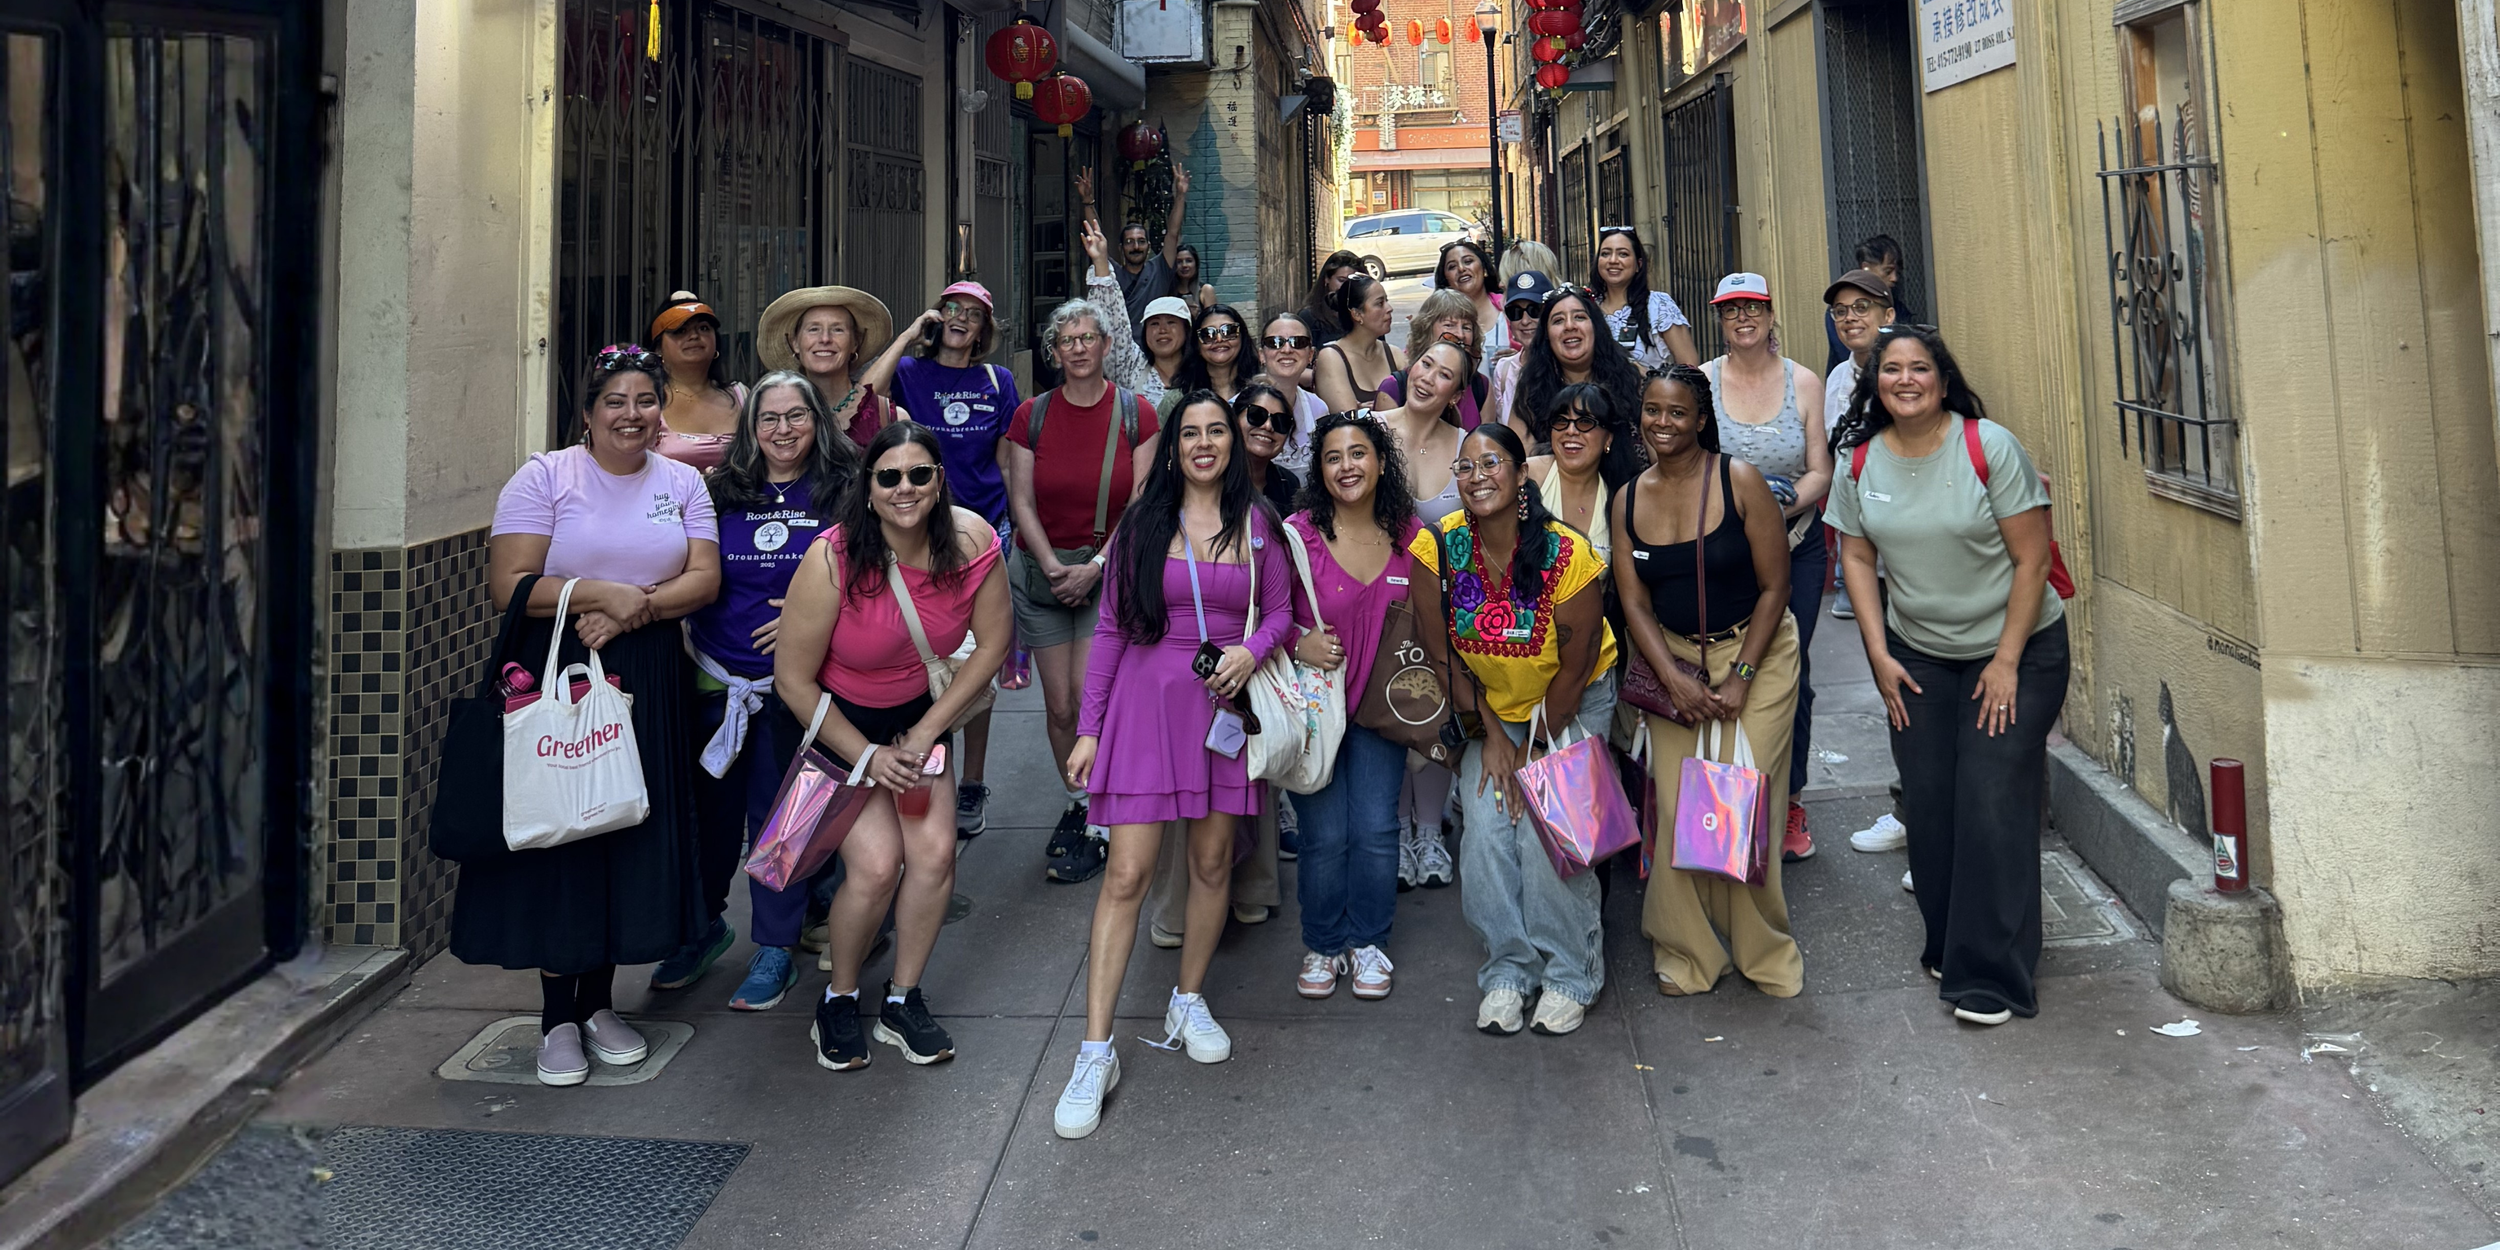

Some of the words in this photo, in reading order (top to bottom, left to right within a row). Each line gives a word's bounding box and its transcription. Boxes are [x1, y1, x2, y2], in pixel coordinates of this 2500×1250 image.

[653, 493, 669, 502] hug
[745, 509, 806, 521] Root&Rise
[727, 552, 804, 561] Groundbreake
[1394, 647, 1430, 665] TO
[537, 723, 623, 759] Greether
